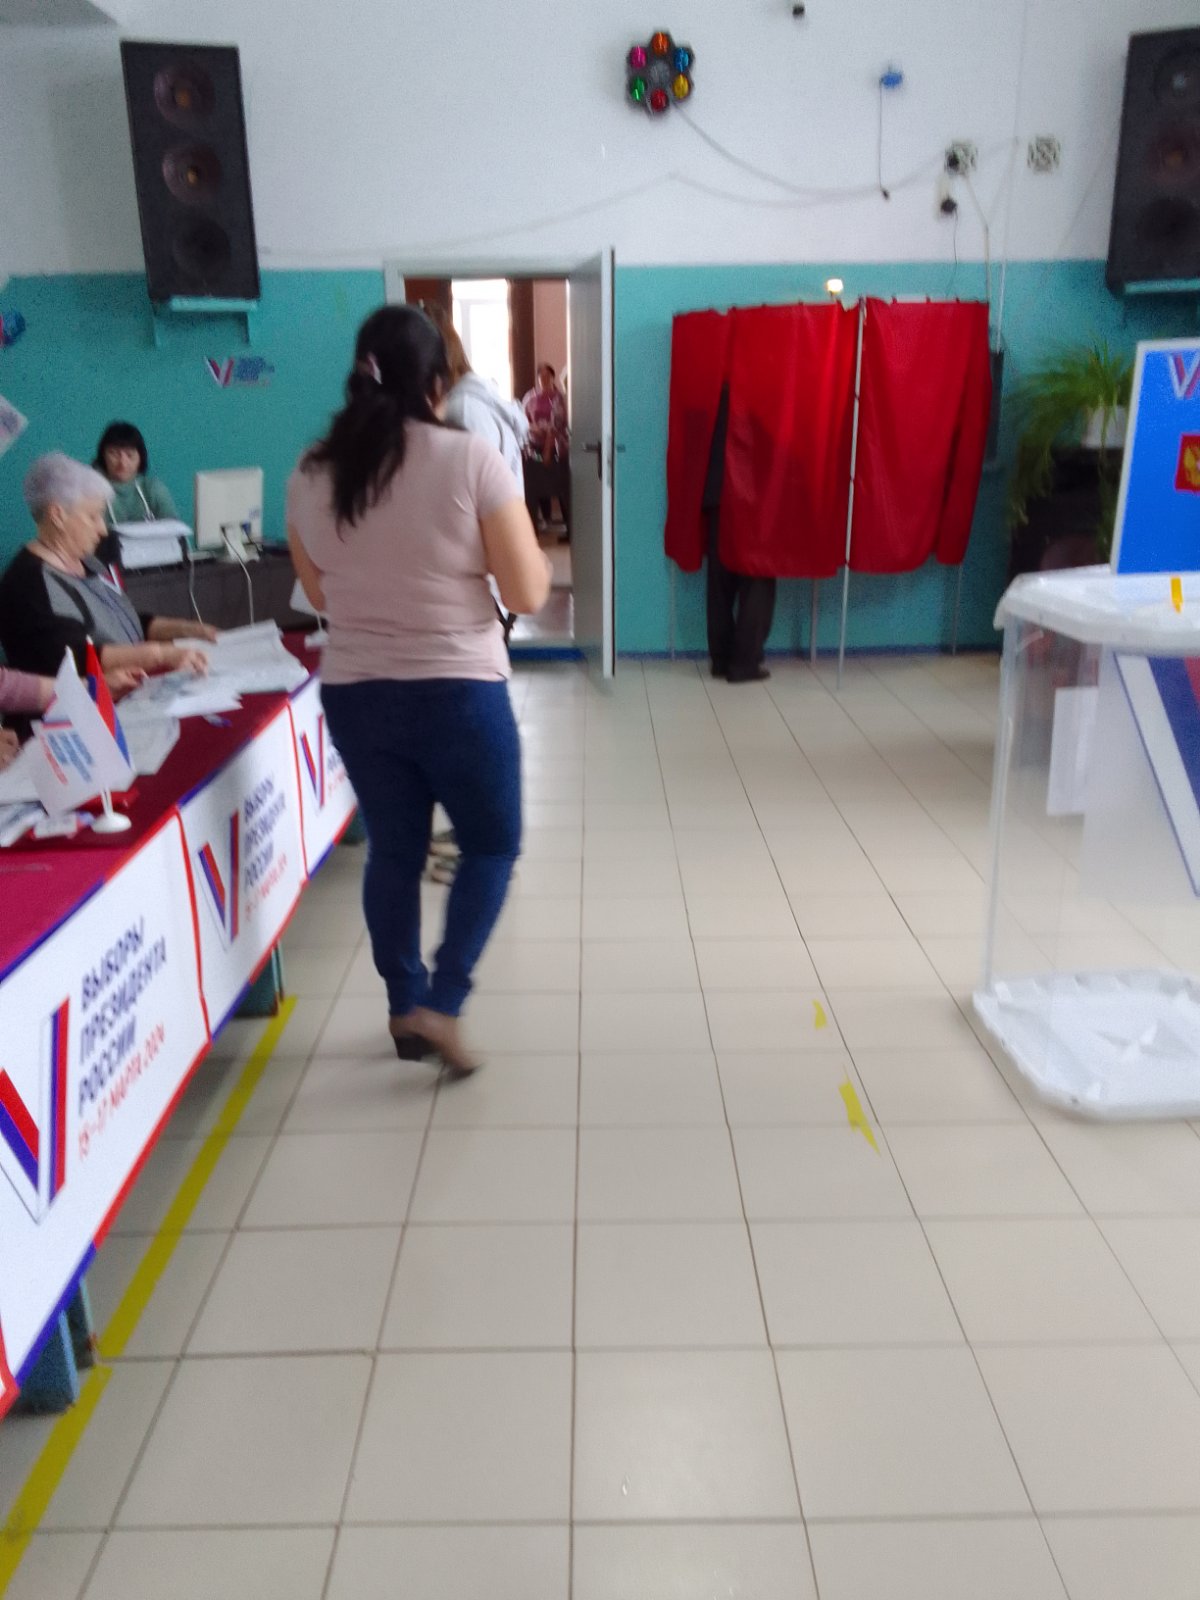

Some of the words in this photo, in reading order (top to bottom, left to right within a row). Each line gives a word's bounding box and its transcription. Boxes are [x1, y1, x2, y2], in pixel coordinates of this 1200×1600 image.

[80, 935, 166, 1065] ПРЕЗИДЕНТА
[81, 915, 144, 1013] ВЫБОРЫ
[79, 1014, 137, 1118] РОССИИ
